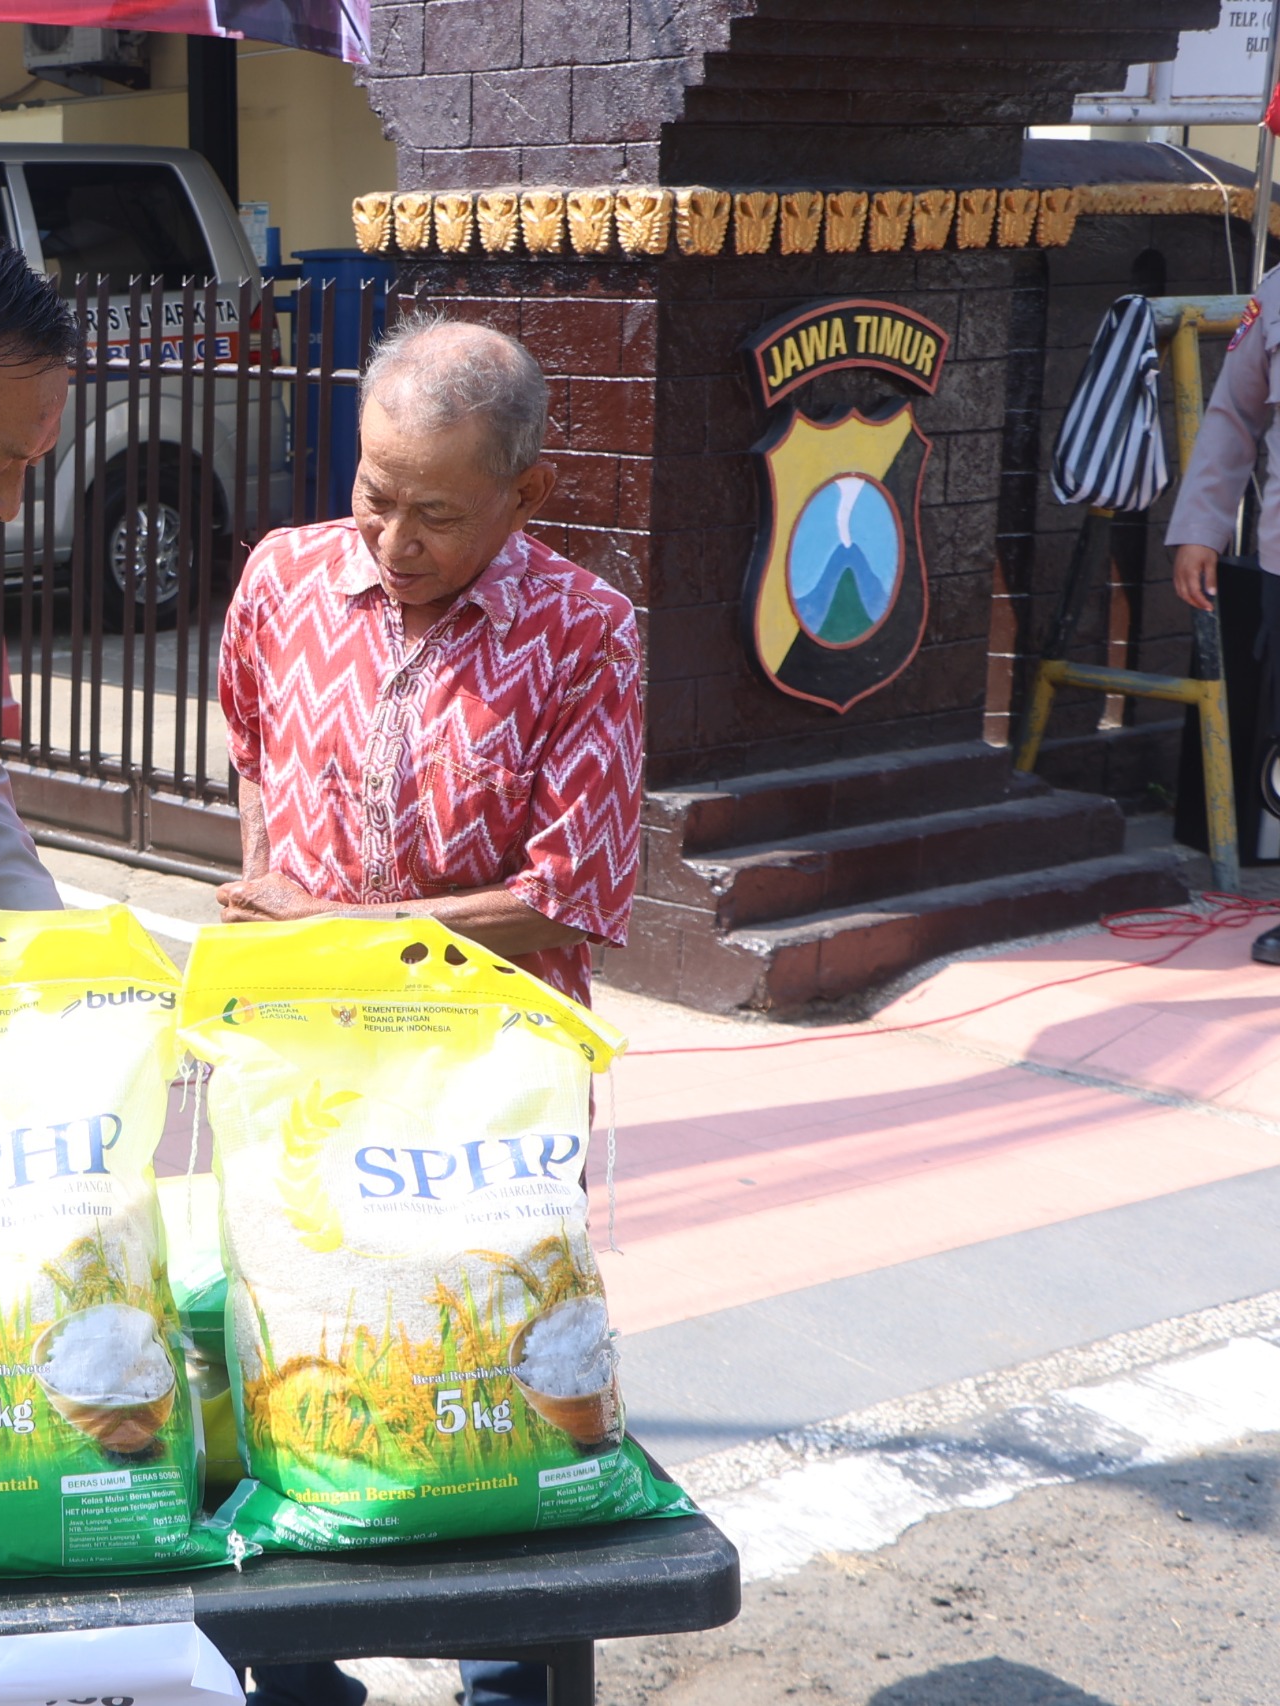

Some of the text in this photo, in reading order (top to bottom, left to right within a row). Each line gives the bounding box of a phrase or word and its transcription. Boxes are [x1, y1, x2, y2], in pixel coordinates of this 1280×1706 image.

[192, 300, 238, 323] KTA
[768, 315, 937, 387] JAWA TIMUR
[87, 986, 177, 1009] bulog
[362, 1006, 478, 1015] KEMENTERIAN KOORDINATOR
[363, 1014, 430, 1023] BIDANG PANGAN
[364, 1024, 451, 1032] REPUBLIK INDONESIA
[354, 1133, 580, 1200] SPHP
[501, 1184, 537, 1198] HARGA
[412, 1373, 446, 1385] Berat
[435, 1389, 513, 1434] 5 kg
[132, 1472, 158, 1483] BERAS
[545, 1472, 571, 1482] BERAS
[573, 1466, 596, 1478] UMUM
[68, 1476, 126, 1488] BERAS UMUM
[286, 1473, 518, 1505] Cadangan Beras Pemerintah
[557, 1488, 576, 1497] Kelas
[578, 1484, 594, 1493] Mutu
[81, 1496, 103, 1505] Kelas
[104, 1494, 124, 1503] Mutu
[129, 1492, 150, 1501] Beras
[151, 1489, 176, 1498] Medium
[65, 1508, 79, 1516] HET
[81, 1507, 104, 1516] (Harga
[105, 1505, 129, 1513] Eceran
[373, 1517, 399, 1527] OLEH:
[338, 1534, 369, 1545] GATOT
